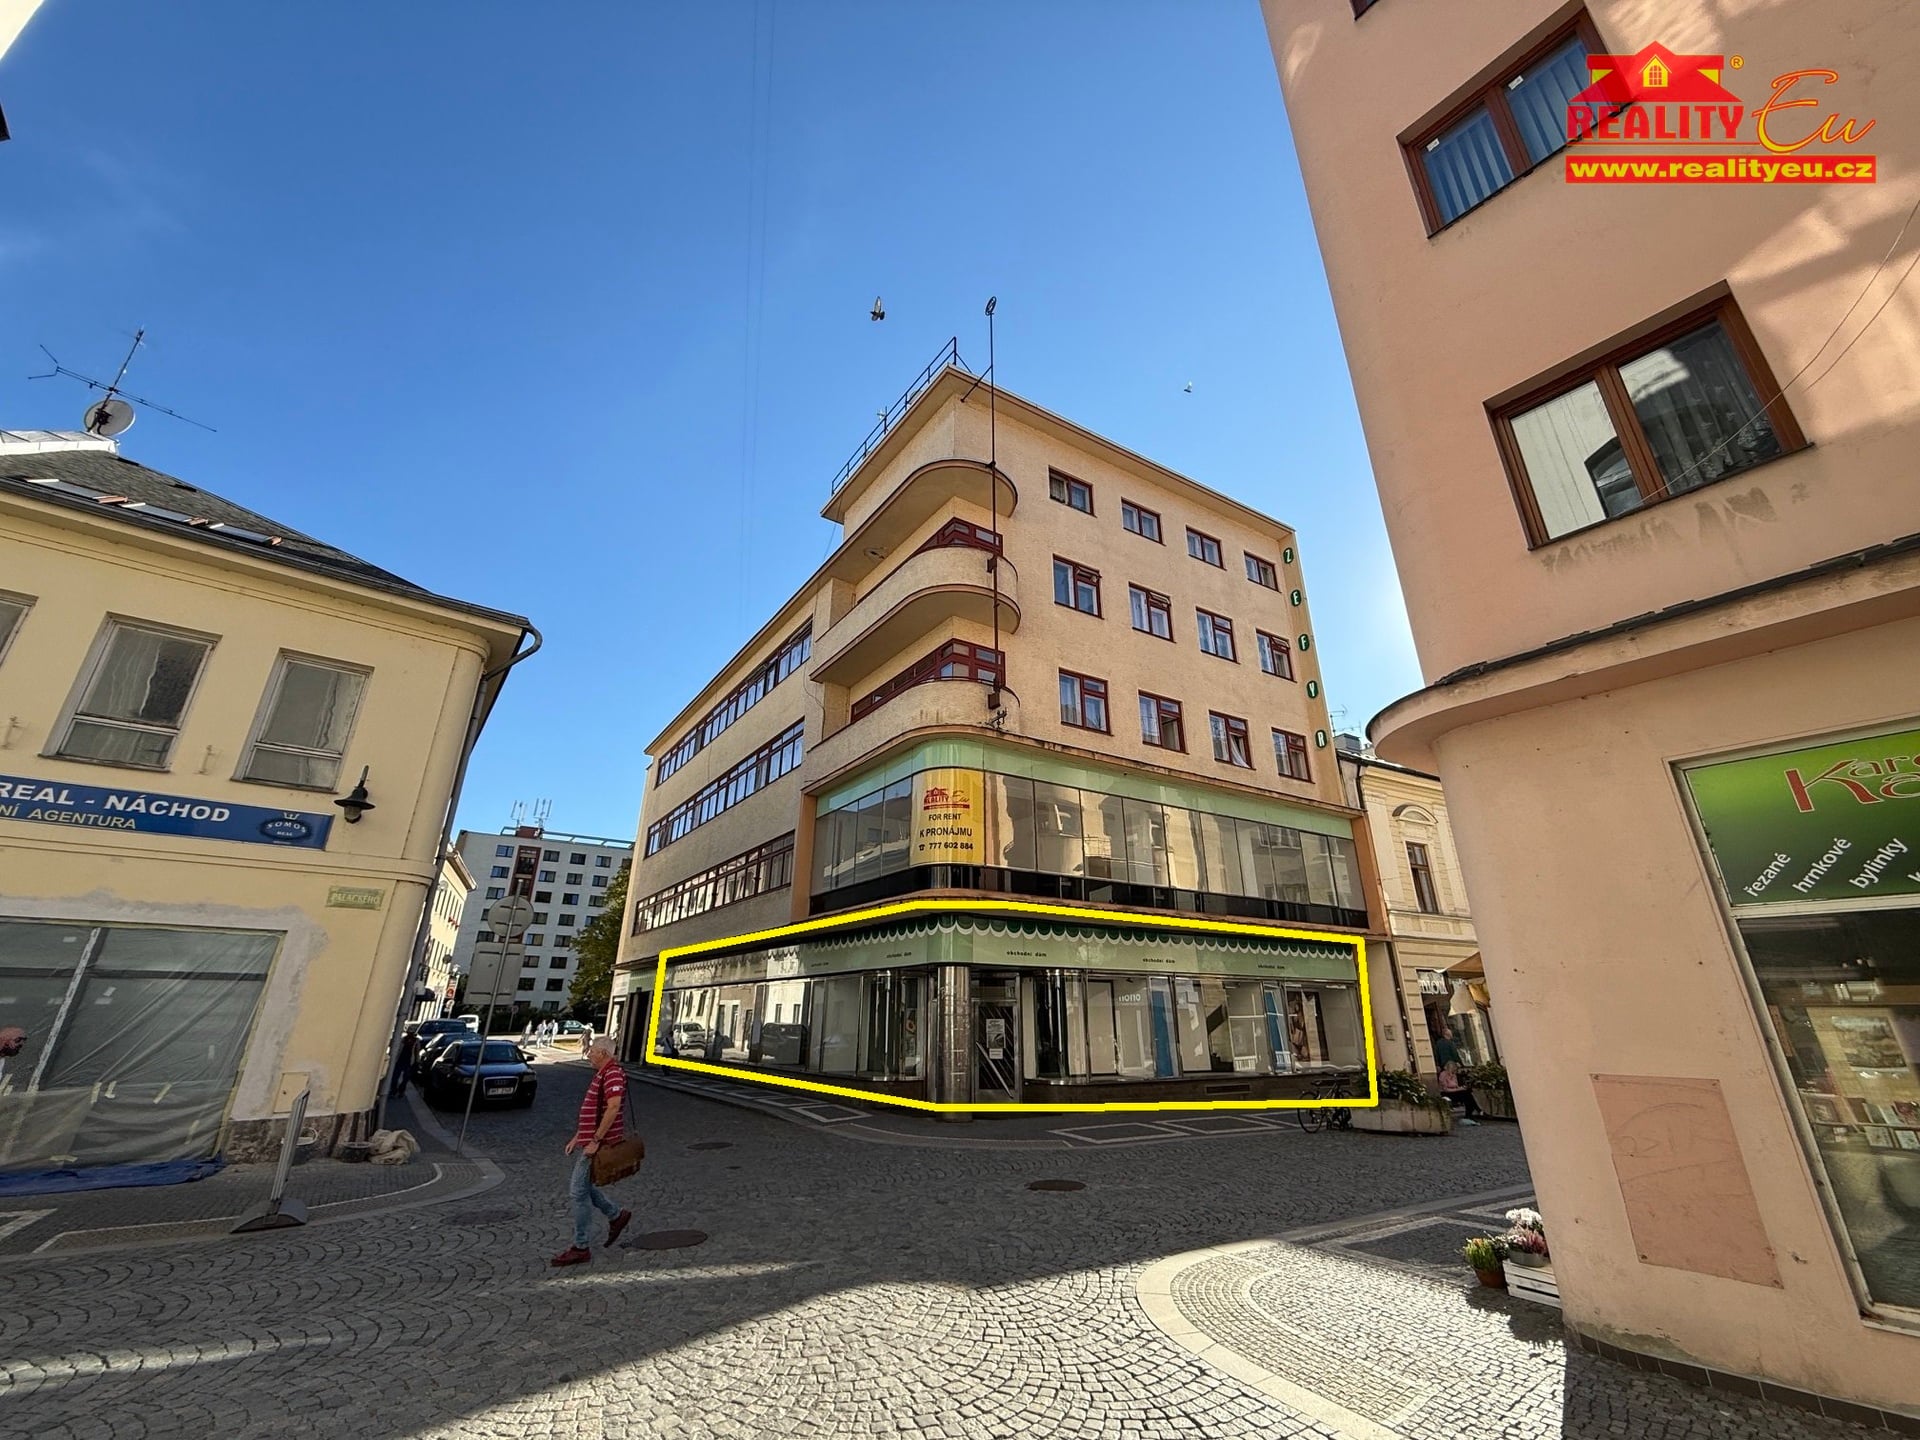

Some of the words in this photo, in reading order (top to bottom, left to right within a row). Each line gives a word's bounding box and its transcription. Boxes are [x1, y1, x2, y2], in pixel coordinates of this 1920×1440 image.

[1284, 548, 1326, 748] ZEFYR
[0, 782, 75, 806] REAL
[104, 795, 230, 822] NÁCHOD
[943, 813, 962, 821] RENT
[27, 808, 136, 830] AGENTURA
[265, 821, 306, 833] SOMOS
[920, 829, 925, 838] K
[926, 825, 973, 837] PRONÁJMU
[929, 842, 942, 850] 777
[1743, 852, 1791, 897] řezané
[1792, 837, 1852, 894] hrnkové
[1848, 837, 1909, 889] bylinky
